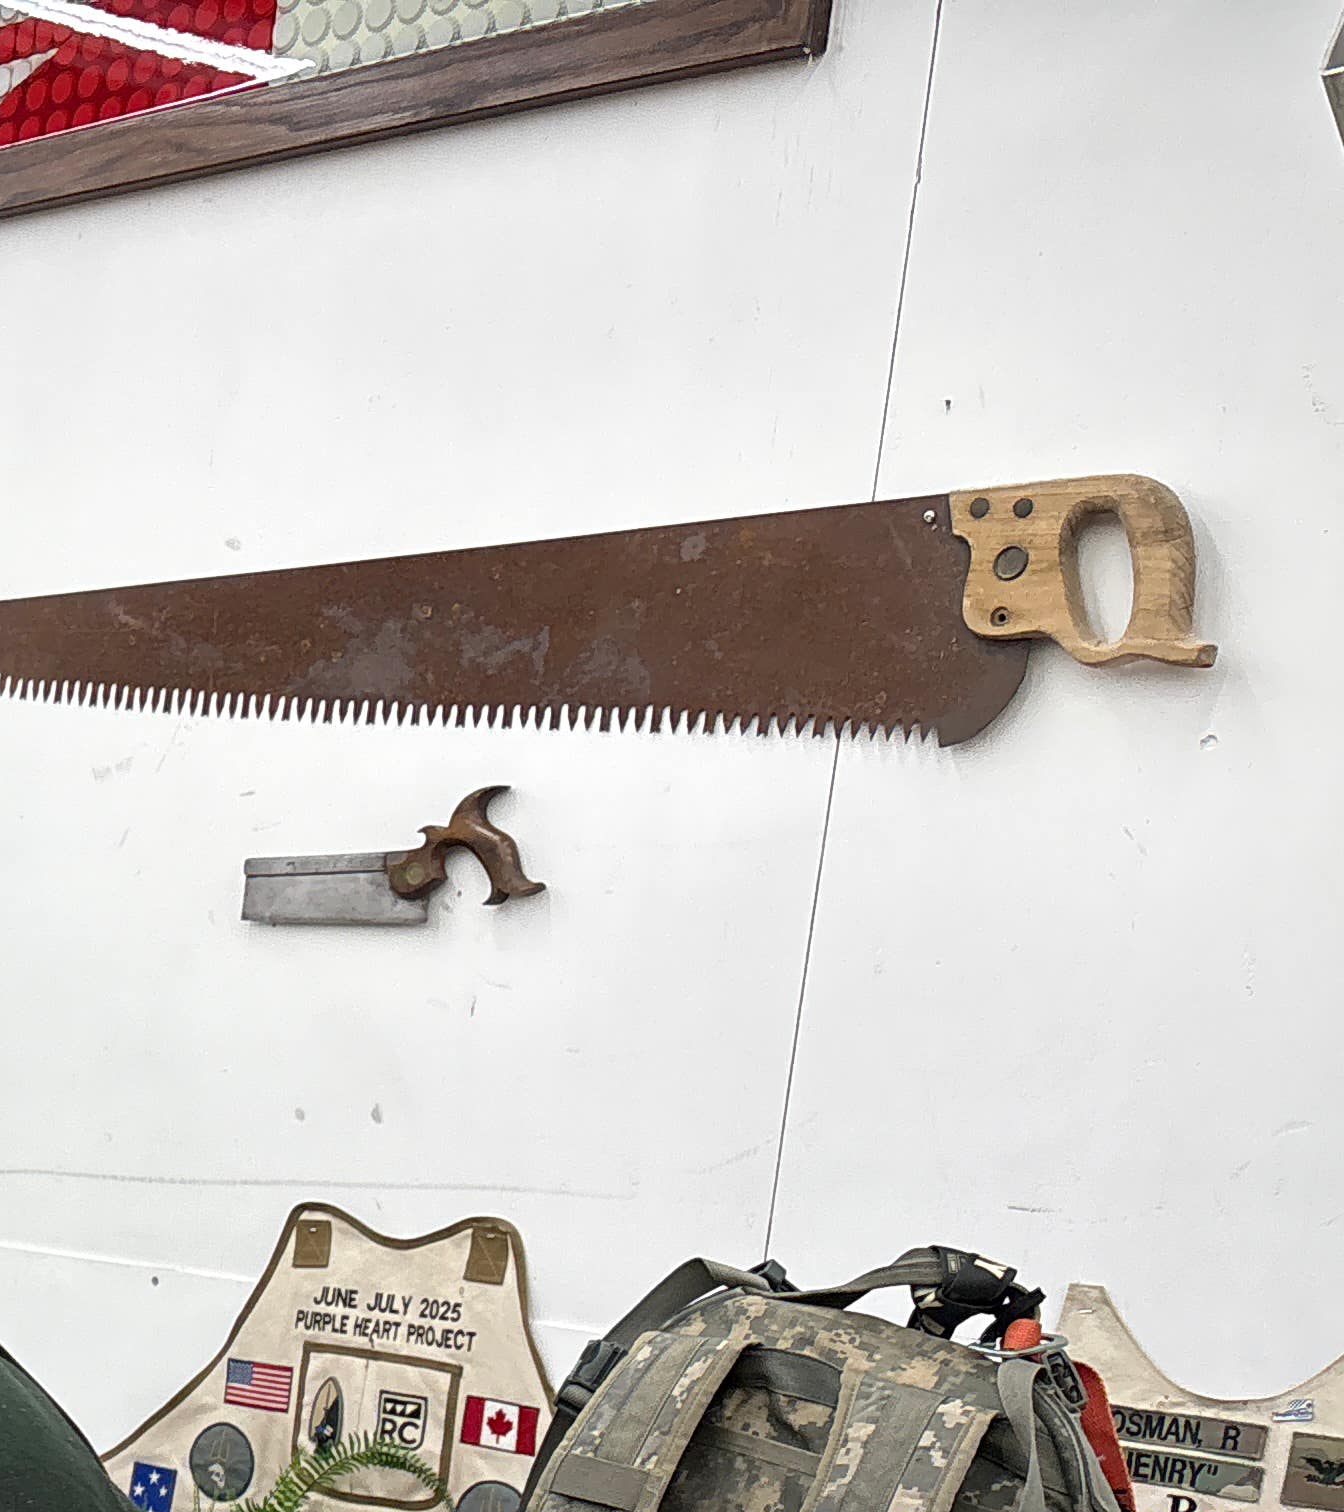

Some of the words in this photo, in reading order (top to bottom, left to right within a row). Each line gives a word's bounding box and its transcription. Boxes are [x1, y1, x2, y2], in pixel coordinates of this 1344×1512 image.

[313, 1285, 359, 1309] JUNE
[366, 1292, 413, 1316] JULY
[419, 1297, 463, 1322] 2025
[295, 1309, 350, 1334] PURPLE
[353, 1316, 402, 1342] HEART
[406, 1323, 477, 1352] PROJECT
[380, 1417, 420, 1445] RC
[1112, 1410, 1201, 1448] OSMAN,
[1221, 1425, 1241, 1450] R
